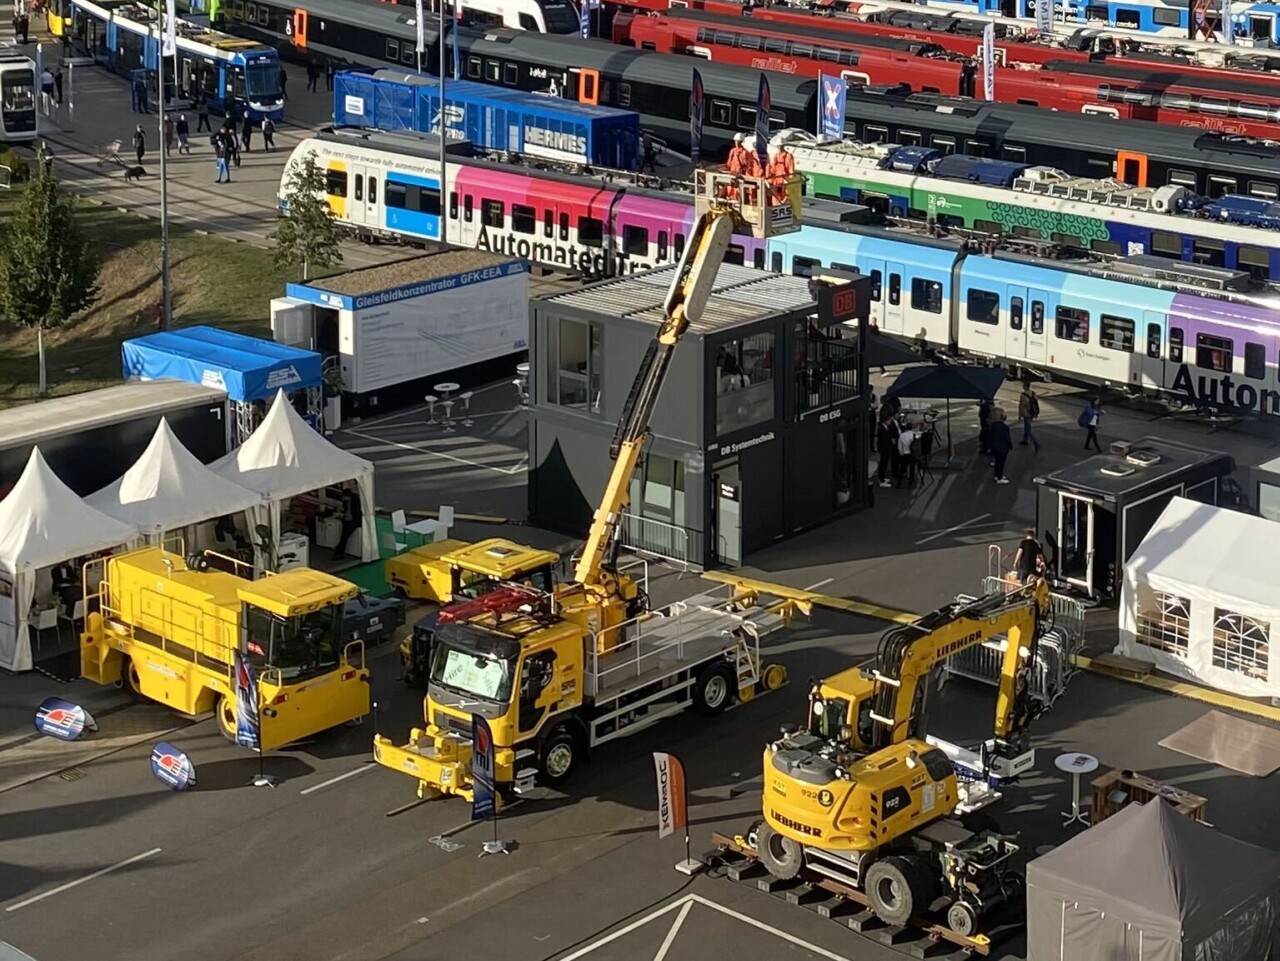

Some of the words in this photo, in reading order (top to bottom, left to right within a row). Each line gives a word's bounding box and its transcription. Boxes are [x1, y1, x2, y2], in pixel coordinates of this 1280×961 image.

[525, 126, 586, 154] HERMES
[771, 207, 793, 220] SRS
[356, 278, 456, 309] Gleisfeldkonzentrator
[460, 267, 502, 285] GFK-EEA
[835, 293, 852, 313] DB
[720, 445, 731, 456] DB
[731, 432, 775, 452] Systemtechnik
[937, 630, 982, 658] LIEBHERR
[445, 664, 463, 682] Hire
[659, 760, 670, 828] KEMROC
[801, 788, 818, 800] 922
[885, 795, 899, 808] 922
[770, 809, 822, 837] LIEBHERR
